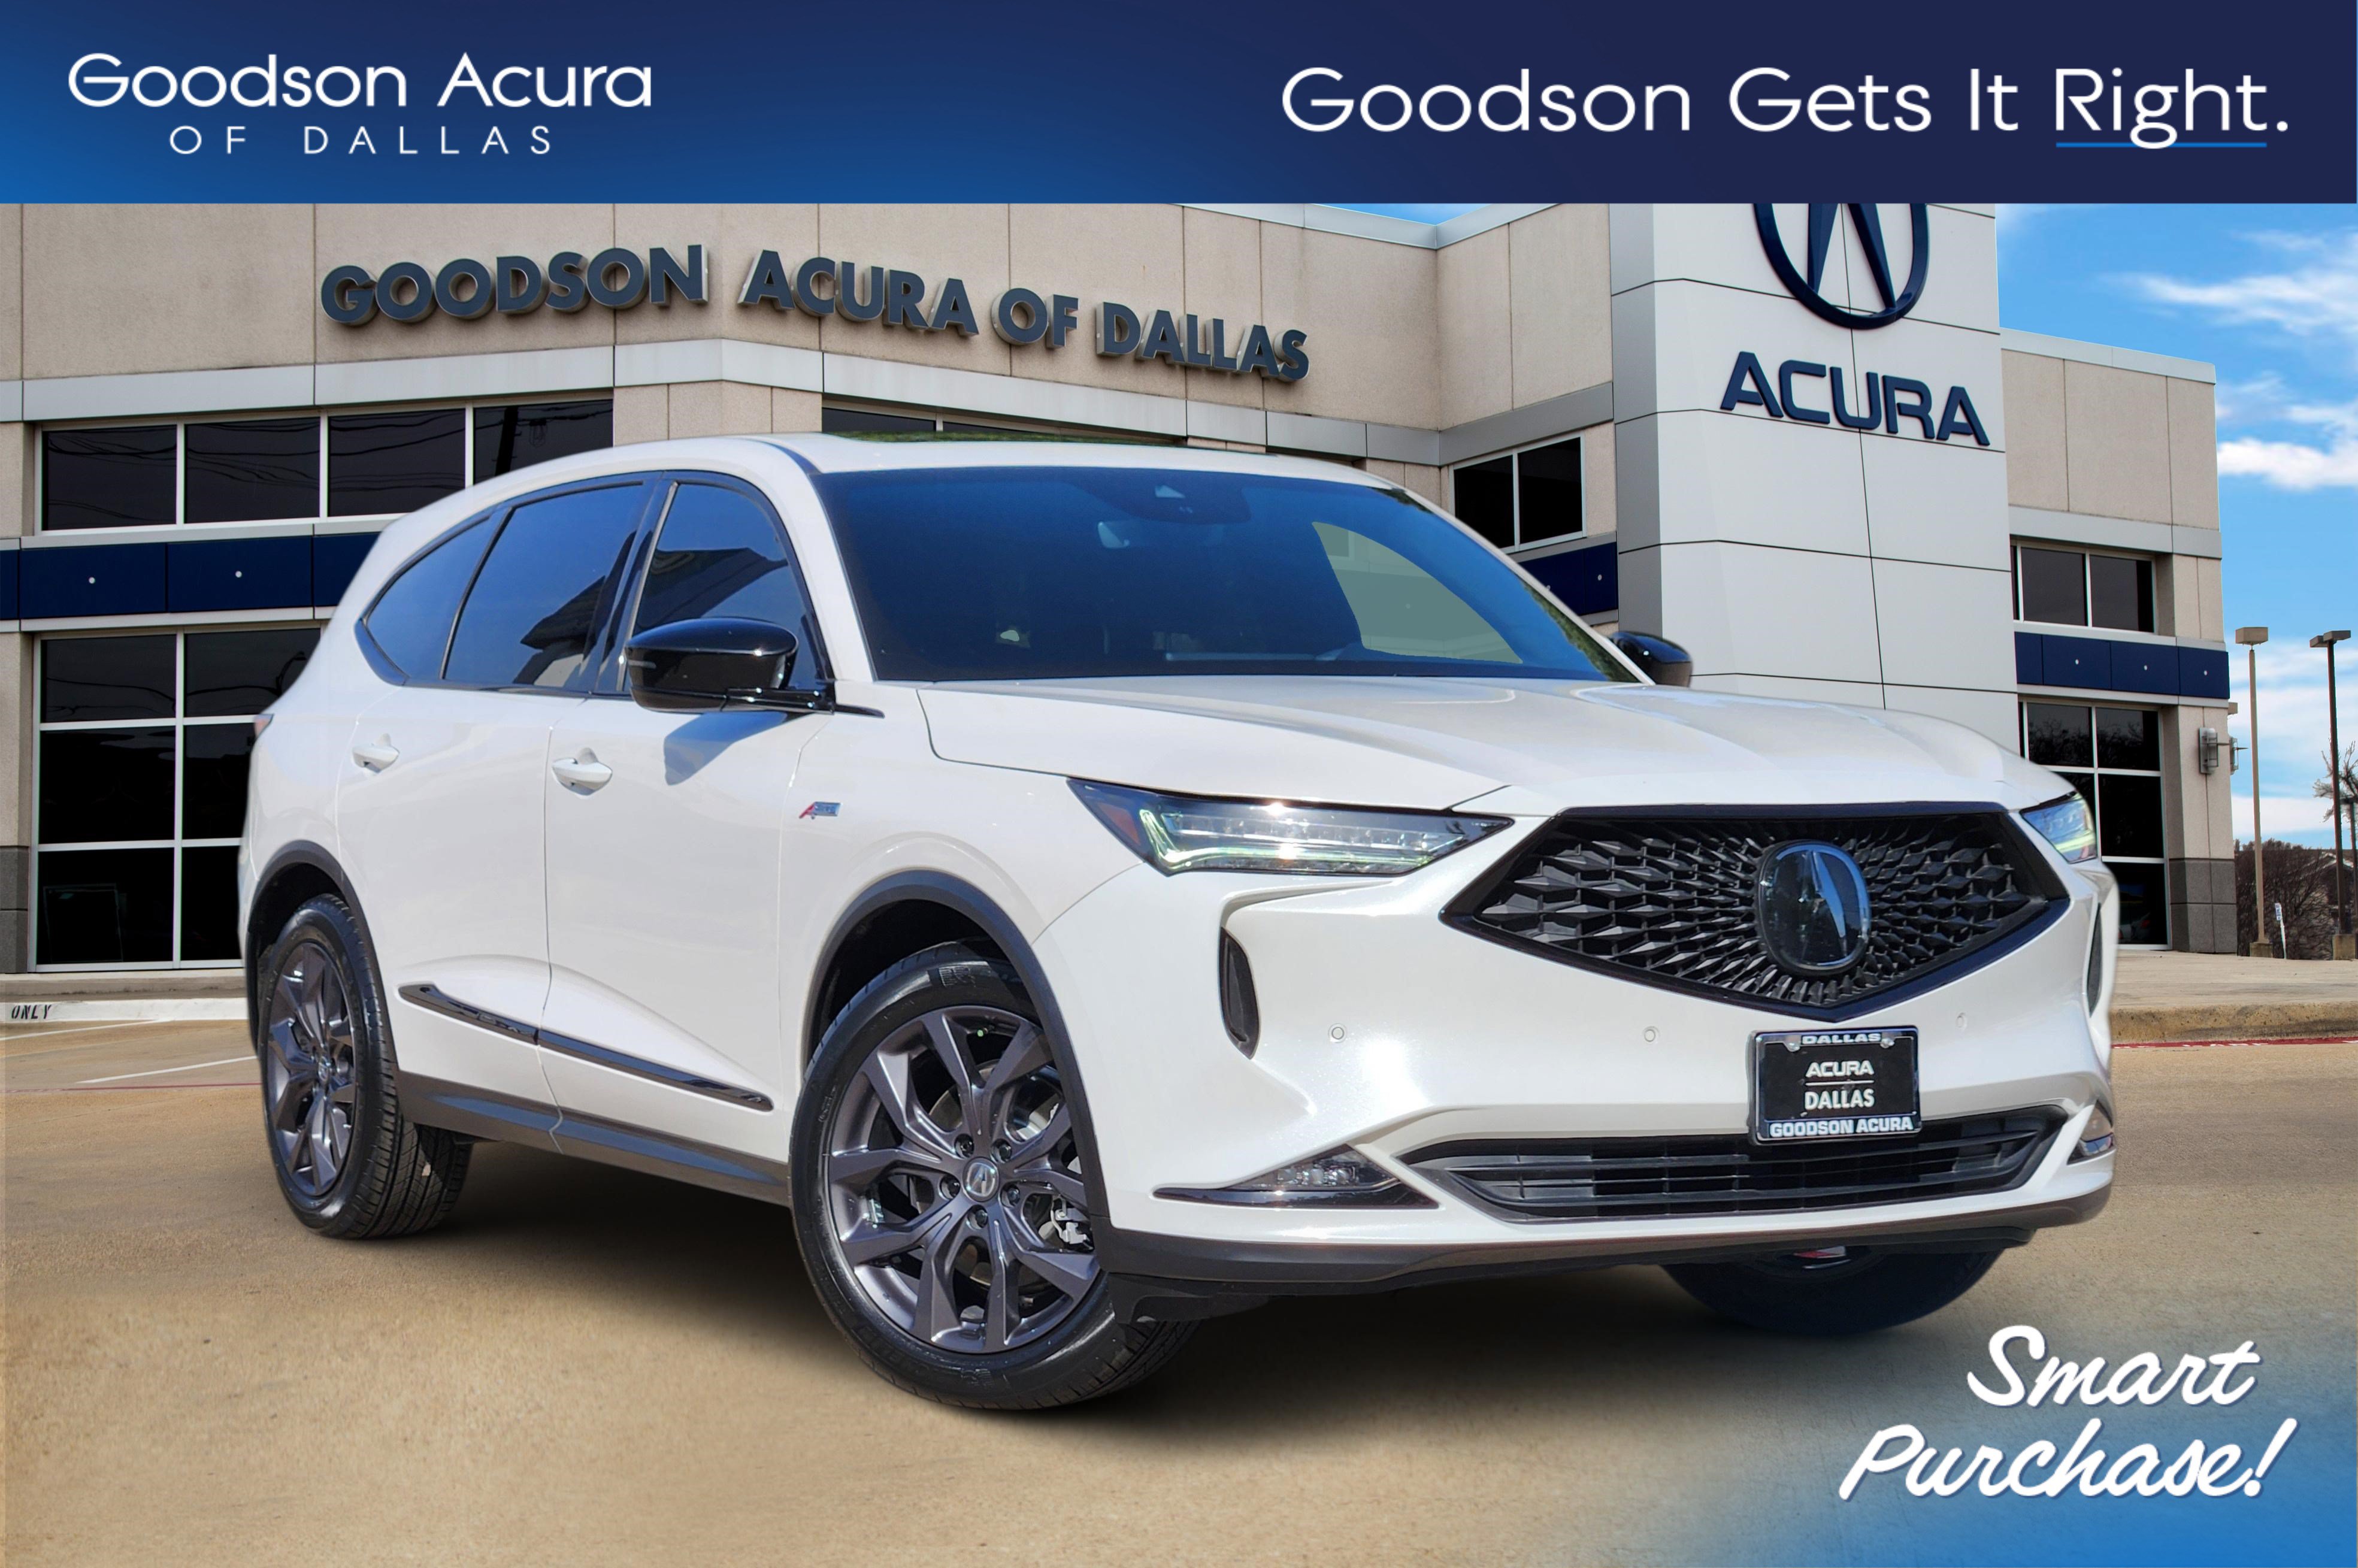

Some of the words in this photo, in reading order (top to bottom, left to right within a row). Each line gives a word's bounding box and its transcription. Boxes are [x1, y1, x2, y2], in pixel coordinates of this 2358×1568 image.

[320, 244, 709, 326] GOODSON
[737, 249, 979, 336] ACURA
[991, 287, 1079, 349] OF
[1095, 301, 1310, 383] DALLAS
[1720, 351, 1991, 447] ACURA
[10, 1004, 53, 1020] ONLY
[1802, 1033, 1881, 1045] DALLAS
[1805, 1060, 1875, 1078] ACURA
[1804, 1088, 1875, 1110] DALLAS
[1769, 1119, 1854, 1138] GOODSON
[1855, 1116, 1914, 1133] ACURA
